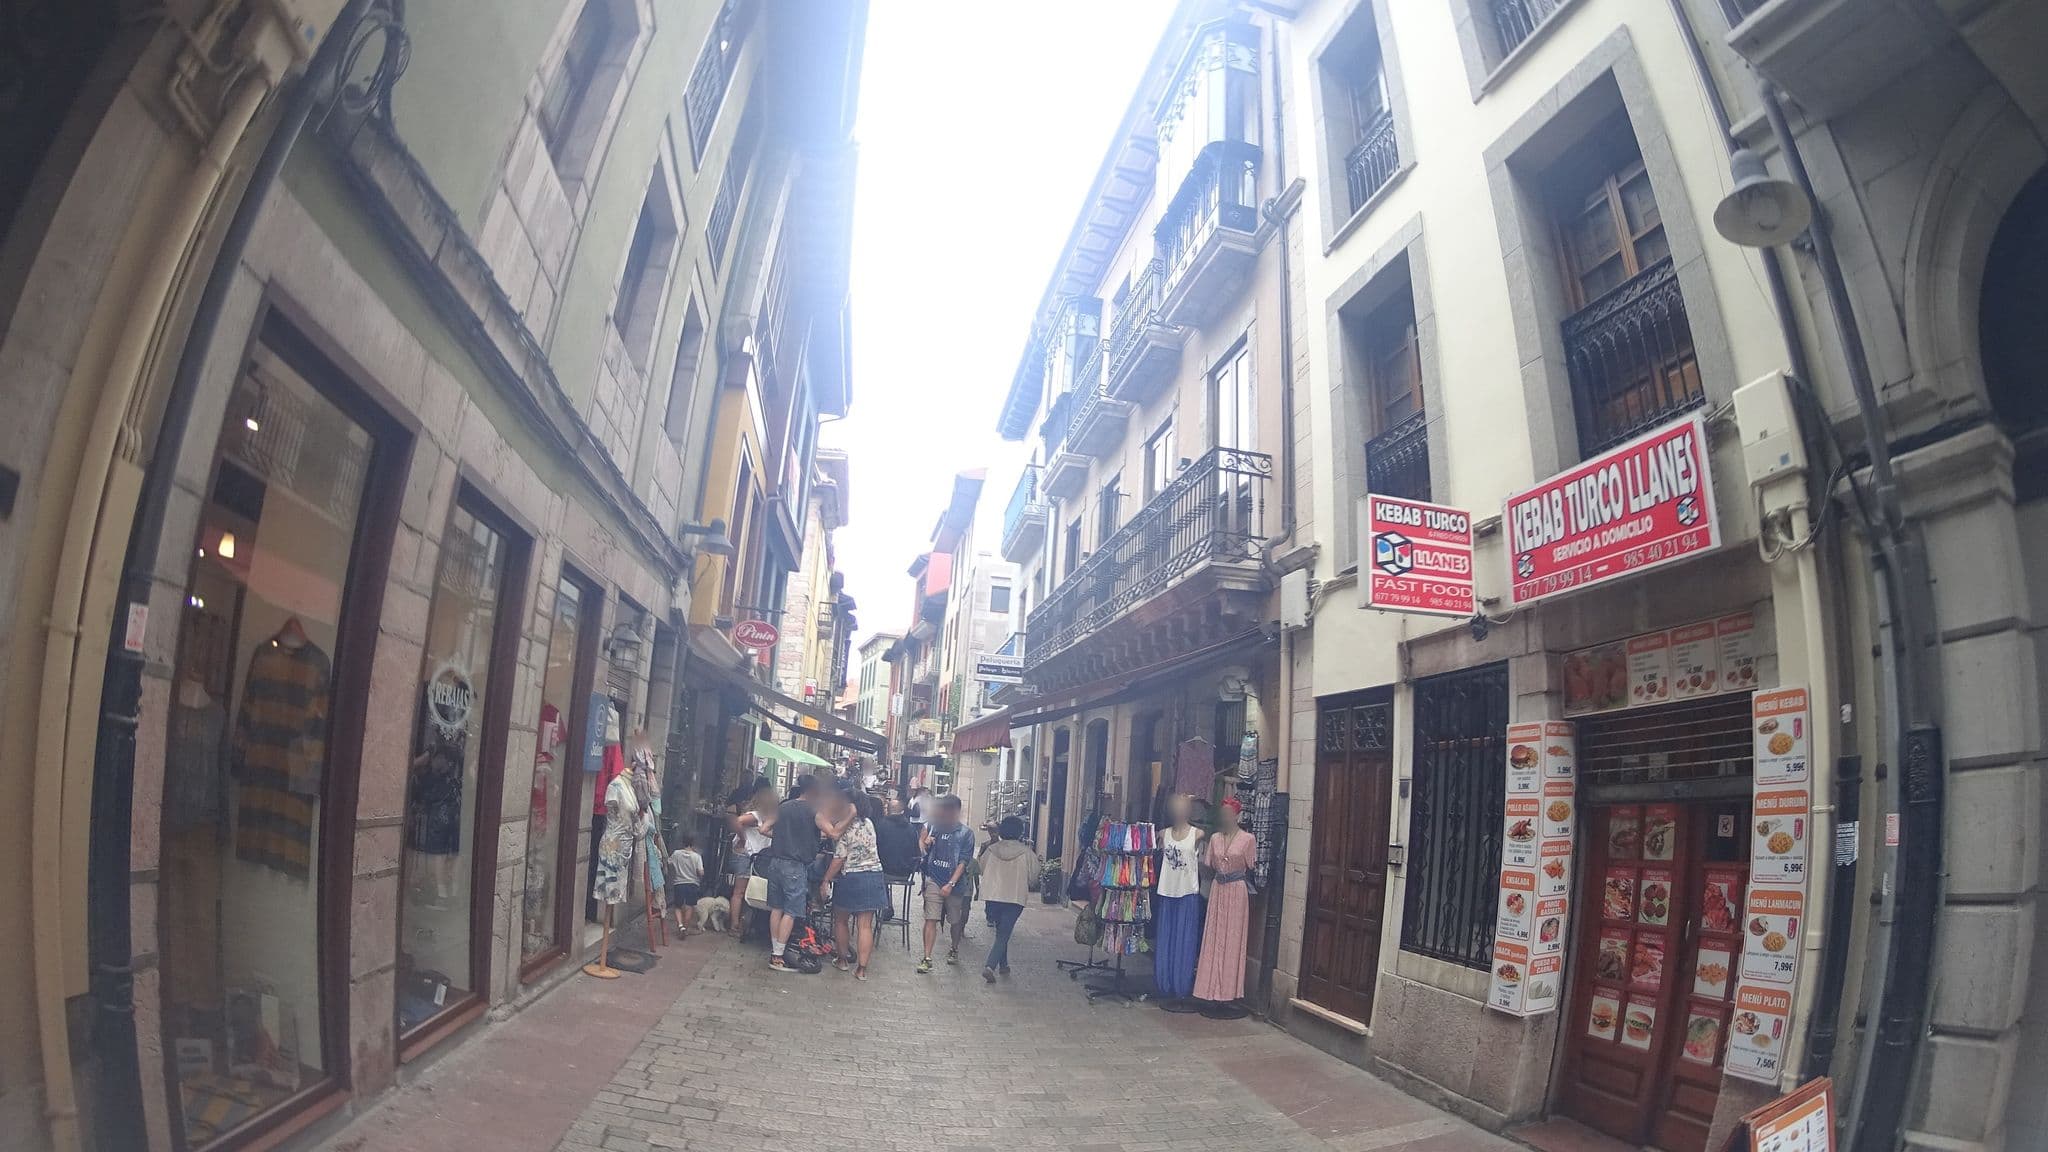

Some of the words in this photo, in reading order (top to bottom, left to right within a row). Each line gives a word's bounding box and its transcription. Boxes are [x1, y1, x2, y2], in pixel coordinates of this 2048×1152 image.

[1512, 488, 1565, 555] KEBAB
[1564, 463, 1624, 536] TURCO
[1624, 431, 1699, 514] LLANES
[1376, 502, 1422, 526] KEBAB
[1424, 510, 1467, 533] TURCO
[1552, 538, 1592, 563] SERVICIO
[1592, 535, 1601, 550] A
[1601, 515, 1653, 547] DOMICILIO
[1413, 549, 1469, 573] LLANES
[1519, 580, 1539, 600] 677
[1543, 576, 1557, 593] 79
[1559, 570, 1574, 588] 99
[1578, 566, 1592, 582] 14
[1623, 549, 1645, 568] 985
[1647, 544, 1662, 562] 40
[1665, 539, 1679, 556] 21
[1682, 532, 1699, 552] 94
[1375, 578, 1418, 592] FAST
[1423, 583, 1472, 598] FOOD
[434, 681, 469, 710] REBAJAS
[1786, 762, 1805, 774] 5,99€
[1757, 796, 1777, 809] MENÚ
[1784, 863, 1803, 873] 6,99€
[1750, 896, 1768, 909] MENÚ
[1774, 961, 1793, 972] 7,99€
[1742, 992, 1761, 1005] MENÚ
[1763, 995, 1787, 1009] PLATO
[1756, 1057, 1776, 1069] 7,50€
